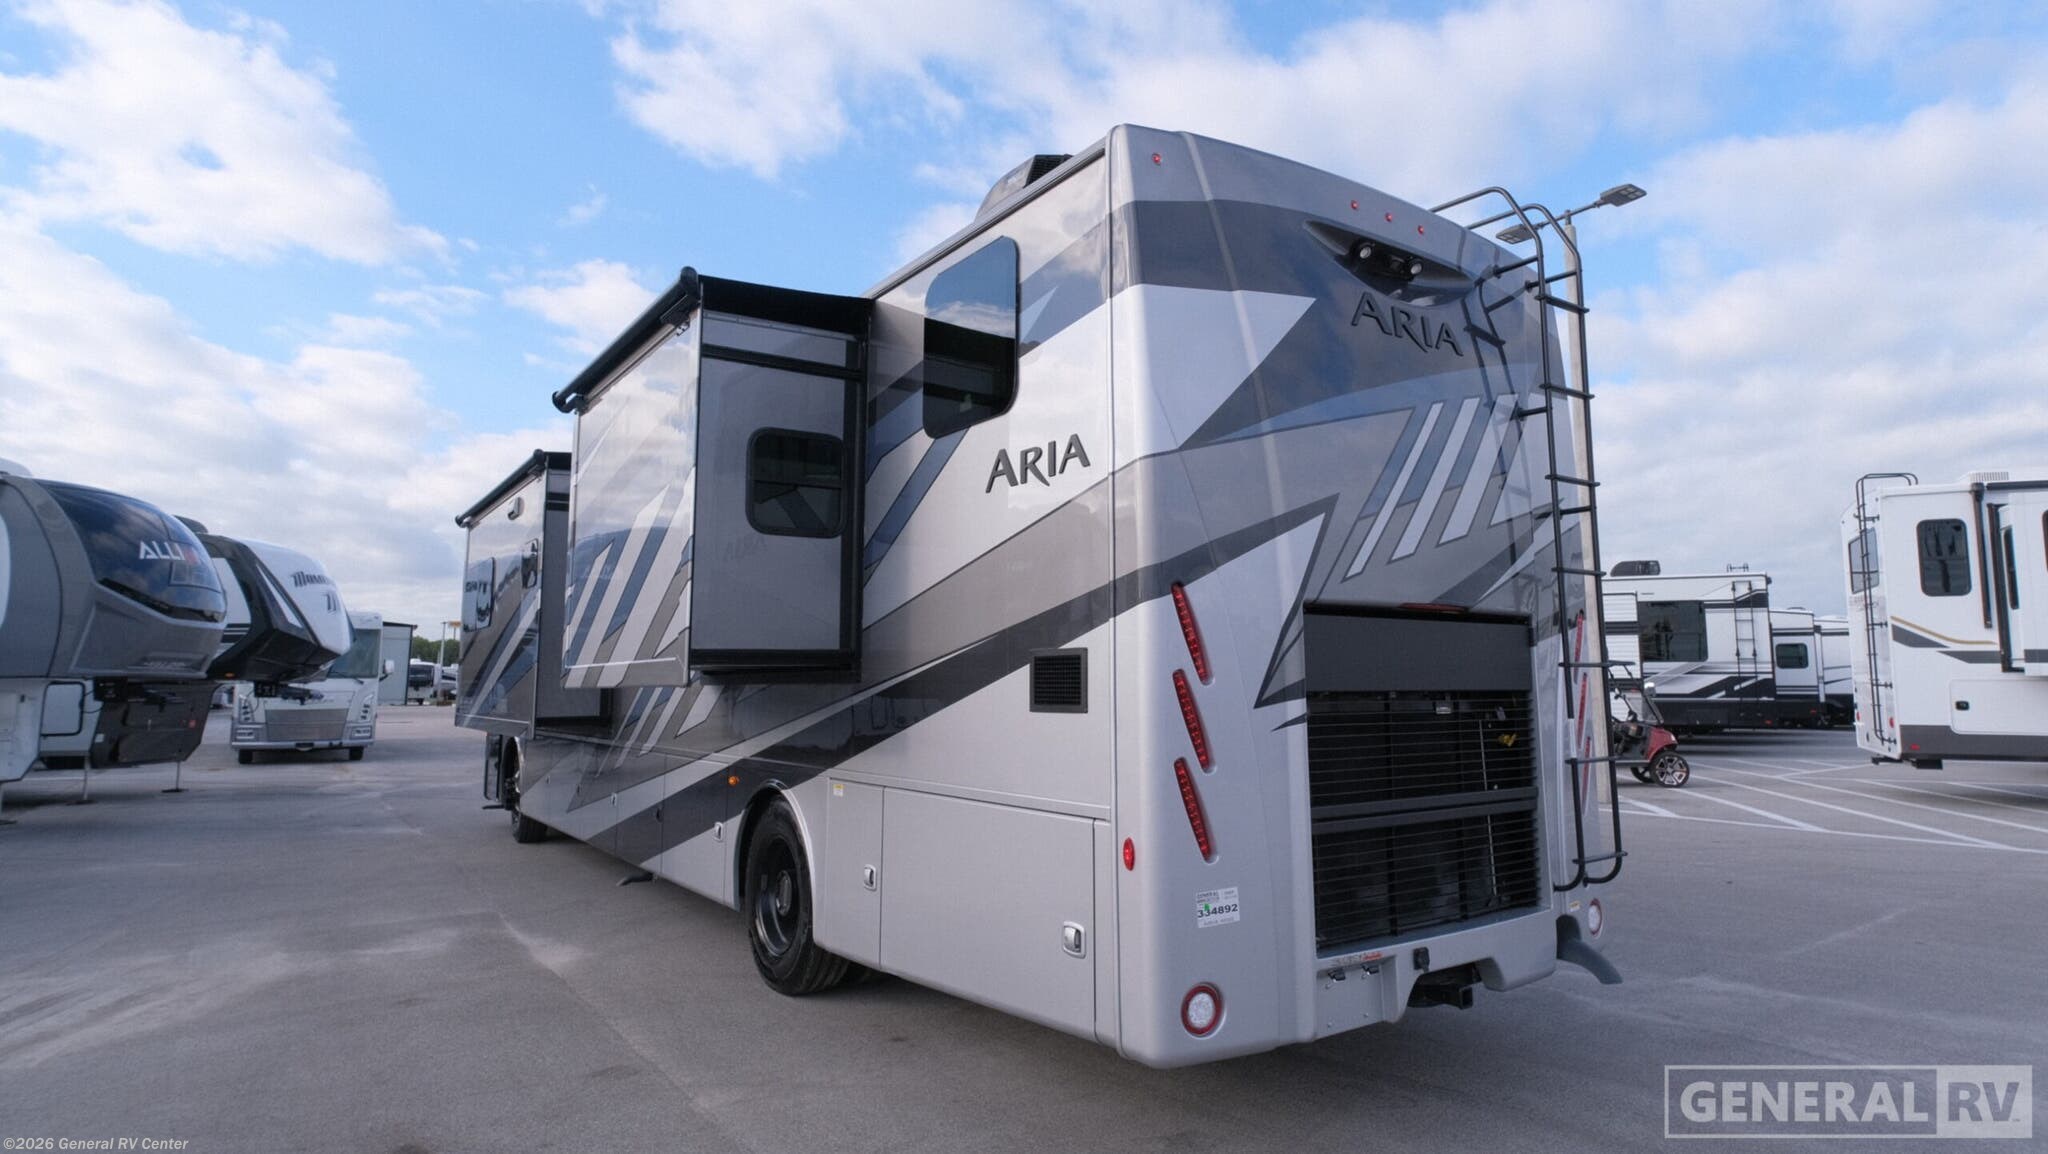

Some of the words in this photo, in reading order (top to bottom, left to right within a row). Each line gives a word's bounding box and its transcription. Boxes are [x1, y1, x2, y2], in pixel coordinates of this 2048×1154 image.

[1350, 291, 1464, 357] ARIA
[985, 433, 1091, 494] ARIA
[1197, 903, 1239, 919] 334892
